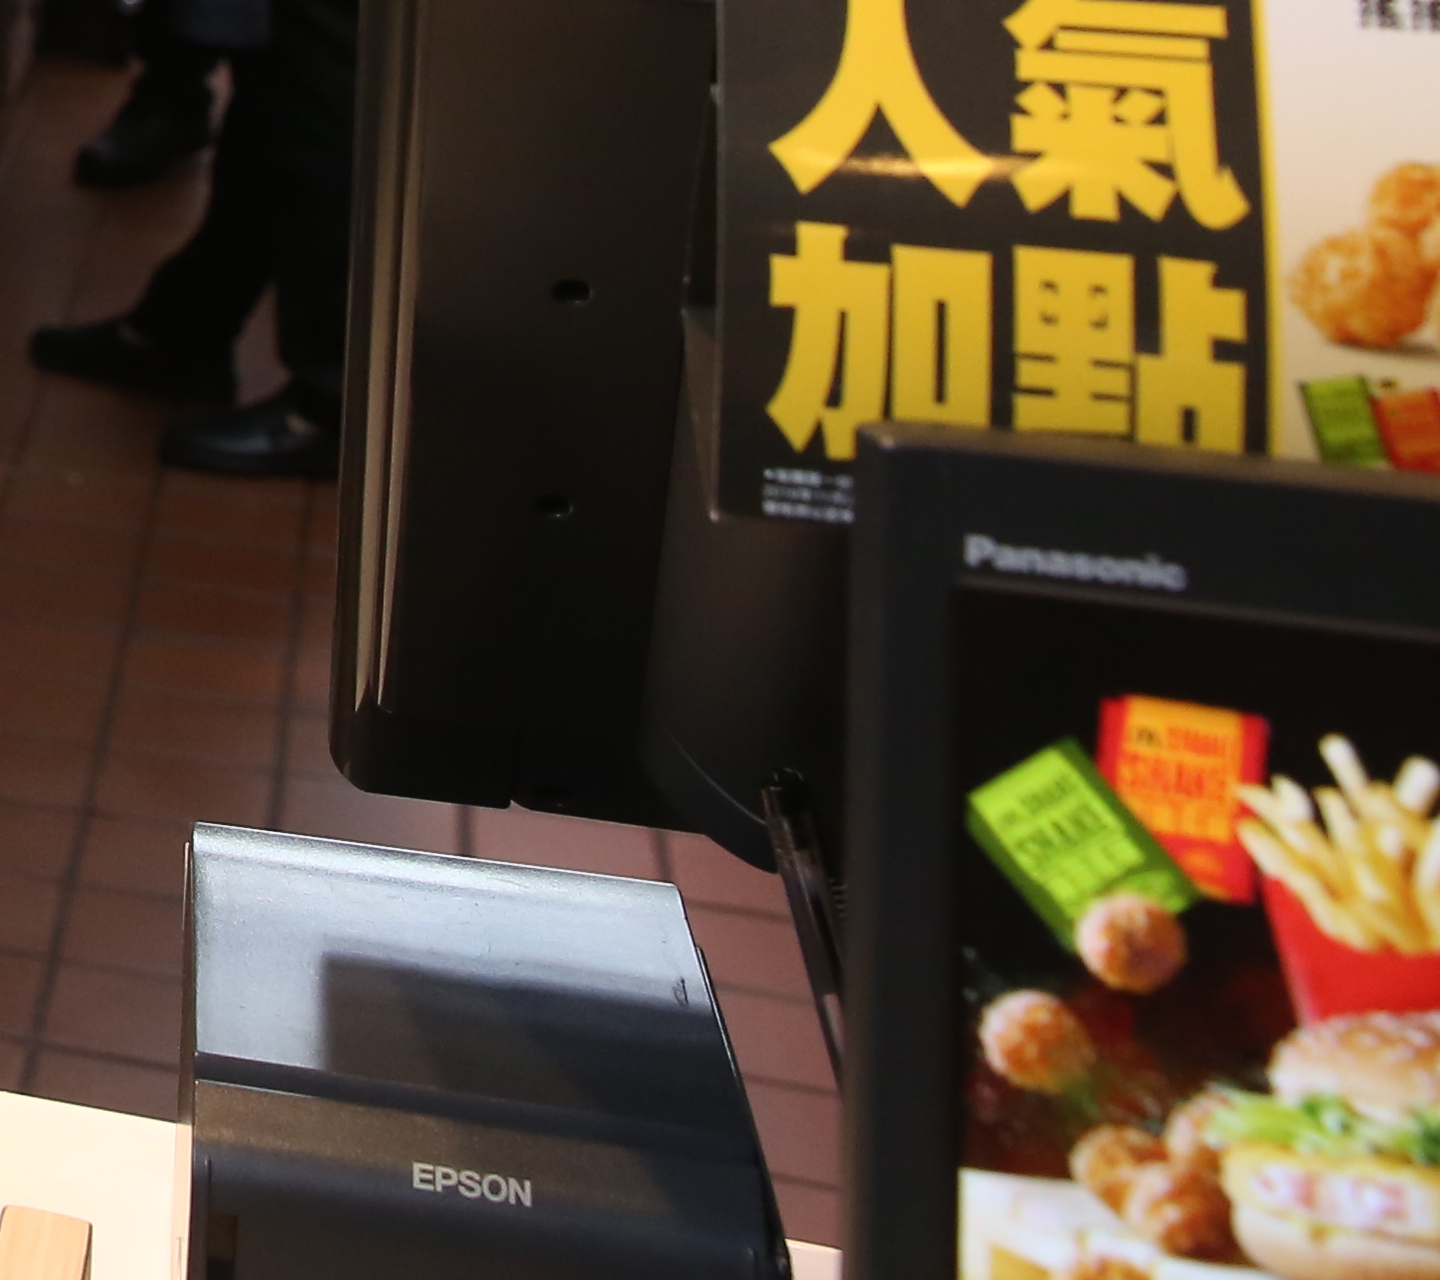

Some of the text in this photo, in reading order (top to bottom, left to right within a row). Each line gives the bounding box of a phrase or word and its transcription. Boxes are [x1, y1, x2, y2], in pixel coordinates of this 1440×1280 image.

[766, 220, 1246, 461] 加點
[962, 533, 1187, 590] Panasonic
[411, 1161, 533, 1208] EPSON
